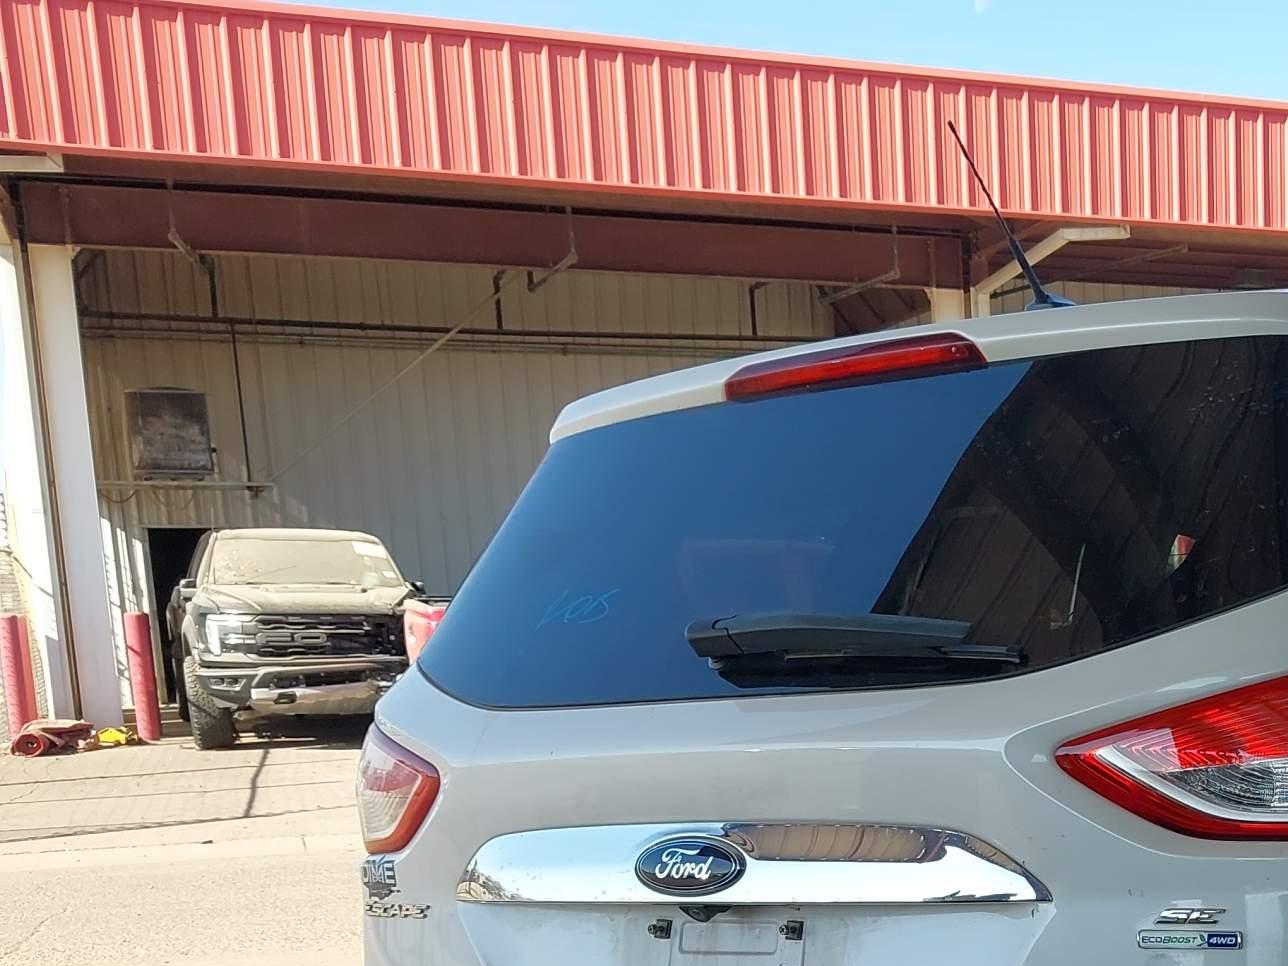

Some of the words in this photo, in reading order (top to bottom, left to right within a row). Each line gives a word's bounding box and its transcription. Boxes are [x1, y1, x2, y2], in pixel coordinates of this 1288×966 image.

[655, 847, 712, 881] Ford
[364, 902, 432, 919] ESCAPE
[1154, 907, 1227, 925] SE
[1209, 936, 1236, 945] 4WD
